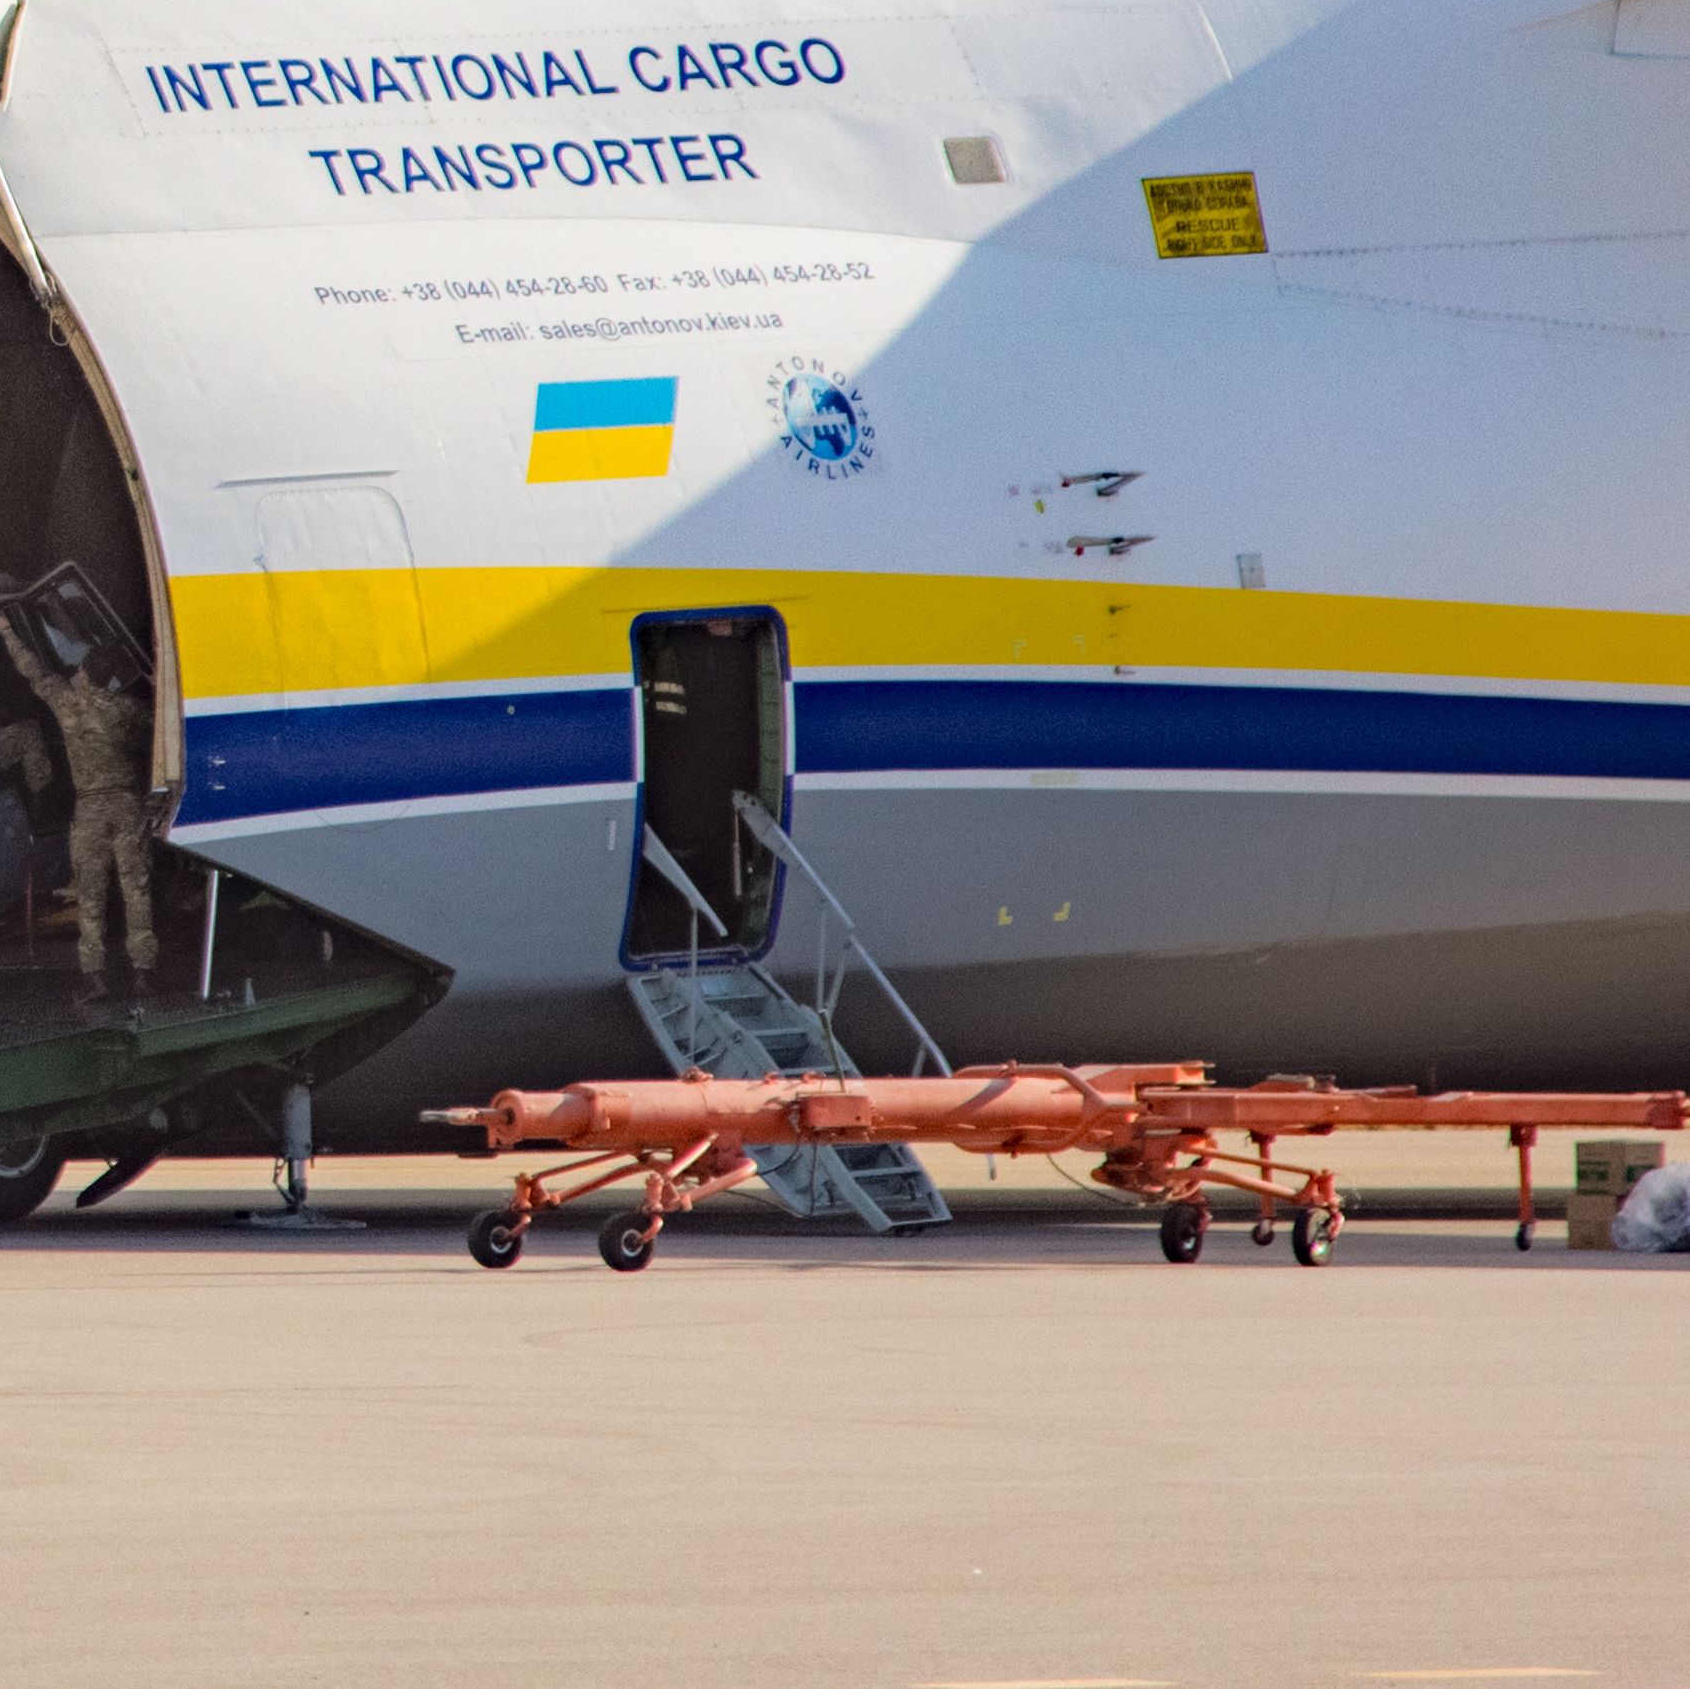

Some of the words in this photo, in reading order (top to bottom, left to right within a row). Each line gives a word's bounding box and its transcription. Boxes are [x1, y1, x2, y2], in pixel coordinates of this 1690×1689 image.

[145, 47, 618, 113] INTERNATIONAL
[628, 37, 847, 93] CARGO
[309, 132, 760, 197] TRANSPORTER
[314, 283, 398, 305] Phone:
[401, 281, 442, 302] +38
[445, 278, 501, 302] (044)
[505, 274, 609, 296] 454-28-60
[617, 273, 668, 293] Fax:
[671, 269, 711, 290] +38
[714, 266, 769, 288] (044)
[774, 261, 875, 284] 454-28-52
[457, 322, 534, 344] E-mail:
[539, 317, 784, 341] sales@antonov.kiev.ua
[767, 356, 863, 410] ANTONOV
[780, 426, 875, 480] AIRLINES
